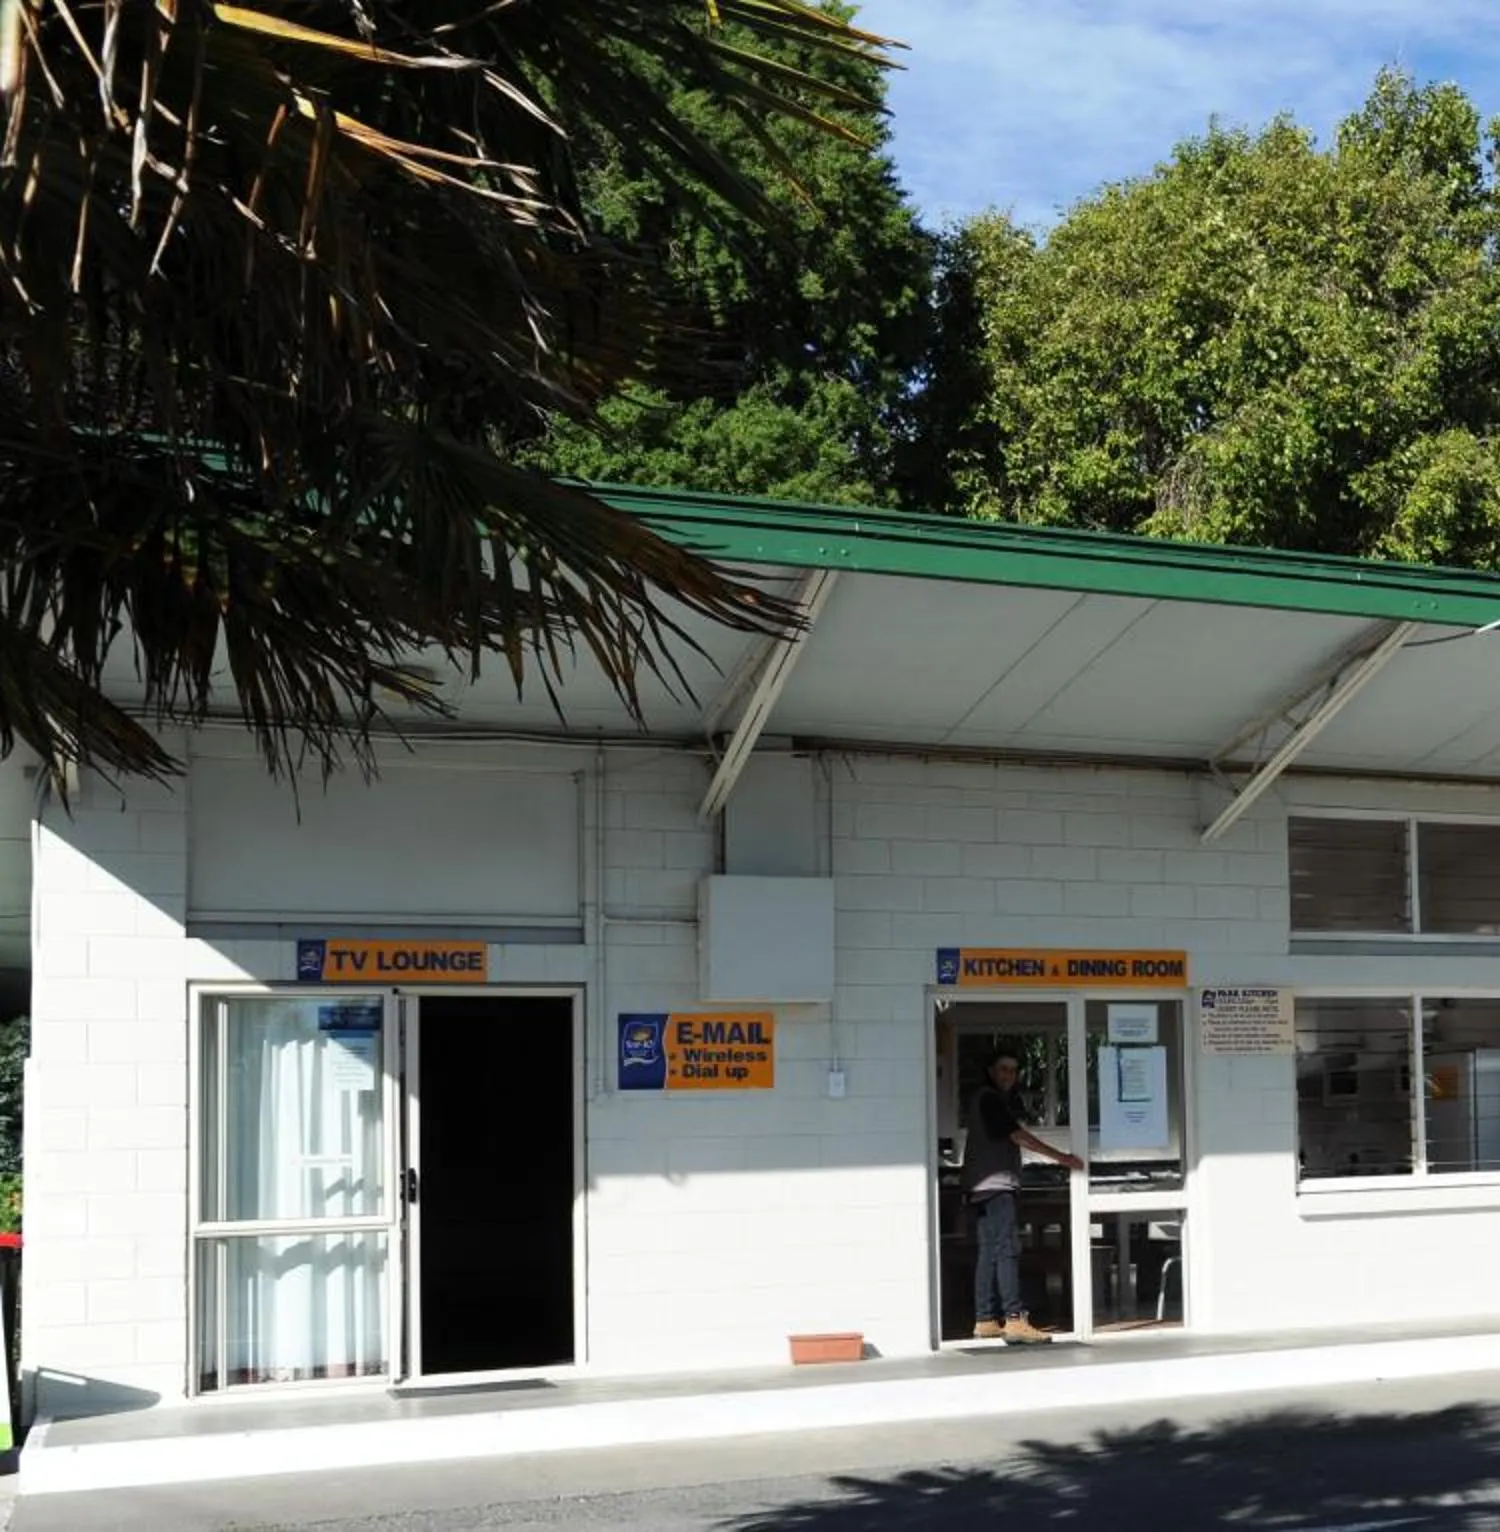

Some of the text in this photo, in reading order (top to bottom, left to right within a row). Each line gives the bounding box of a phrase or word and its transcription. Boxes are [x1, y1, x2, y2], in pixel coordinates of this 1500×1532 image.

[329, 950, 482, 971] TV LOUNGE
[963, 959, 1045, 976] KITCHEN
[1067, 959, 1128, 976] DINING
[1132, 960, 1183, 977] ROOM
[677, 1021, 771, 1045] E-MAIL
[684, 1048, 767, 1063] Wireless
[683, 1063, 749, 1081] Dial up
